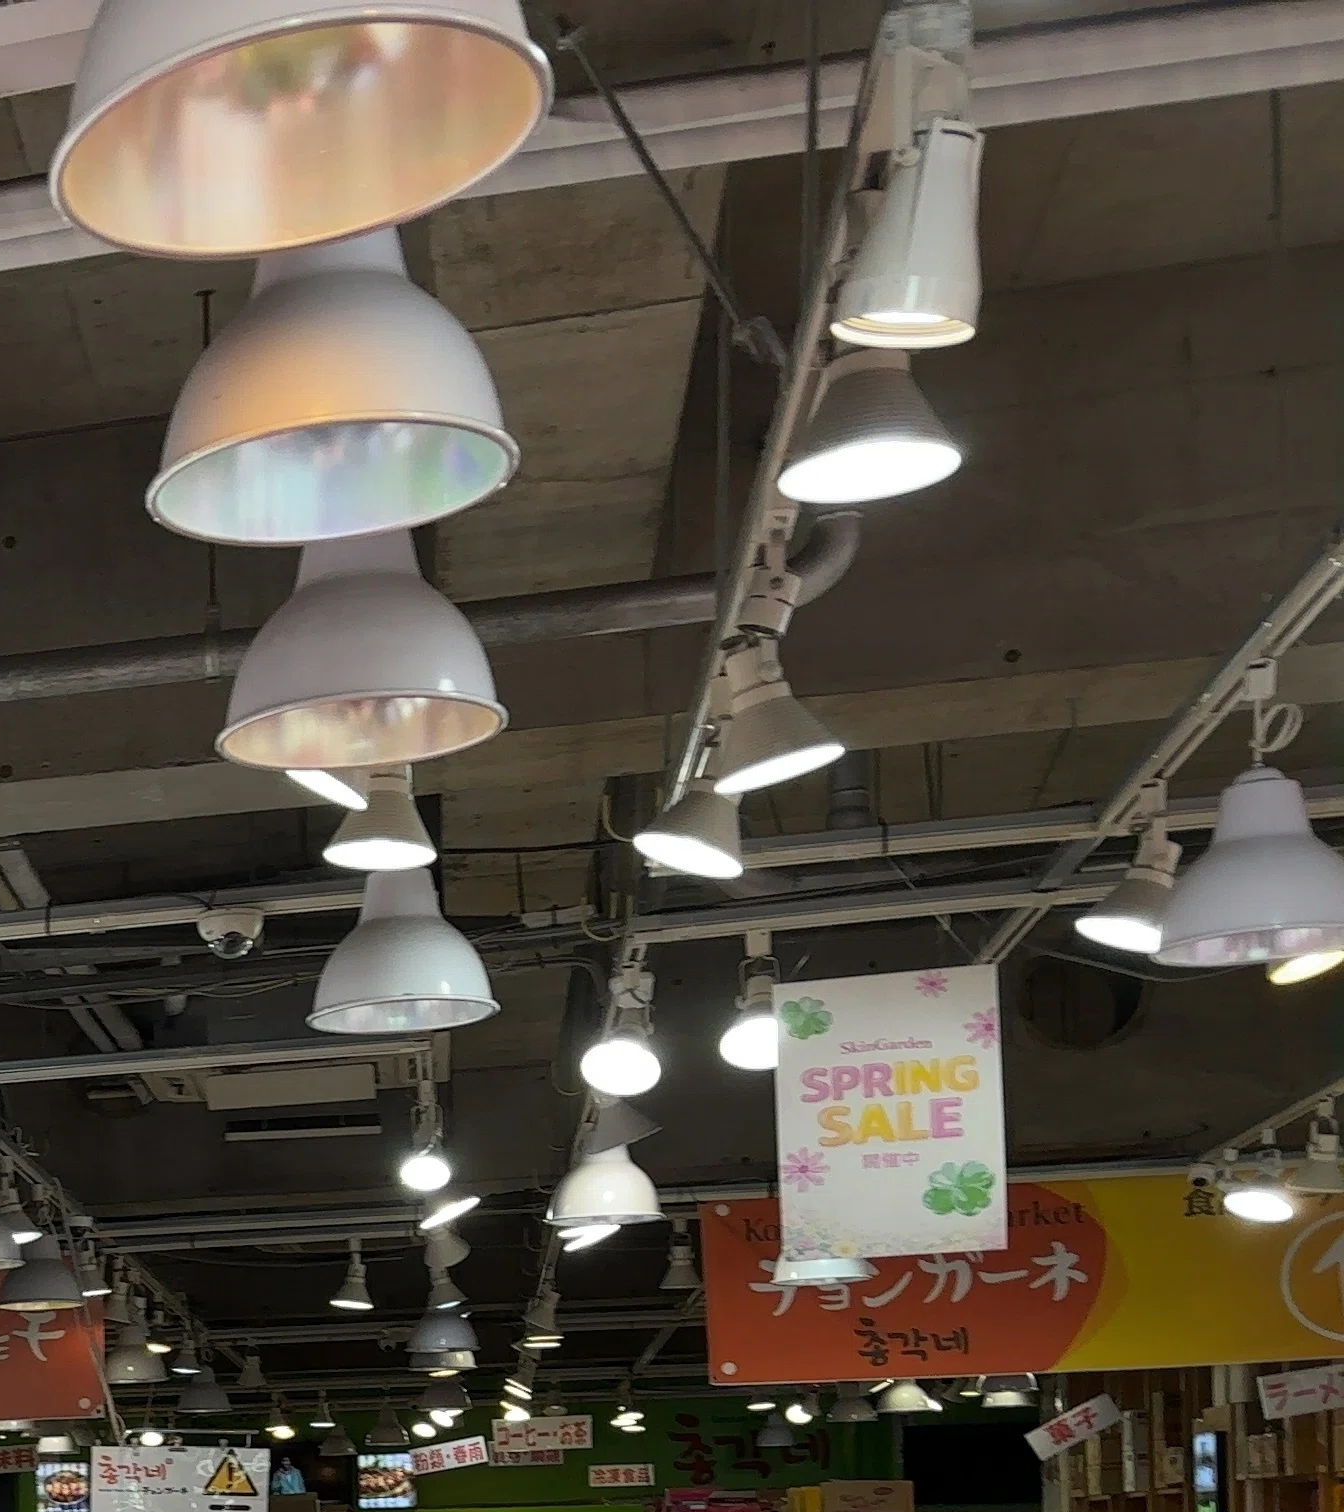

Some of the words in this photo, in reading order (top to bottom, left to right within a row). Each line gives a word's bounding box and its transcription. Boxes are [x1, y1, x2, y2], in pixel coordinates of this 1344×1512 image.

[800, 1054, 980, 1103] SPRING
[818, 1097, 964, 1147] SALE
[855, 1318, 970, 1366] 총각네
